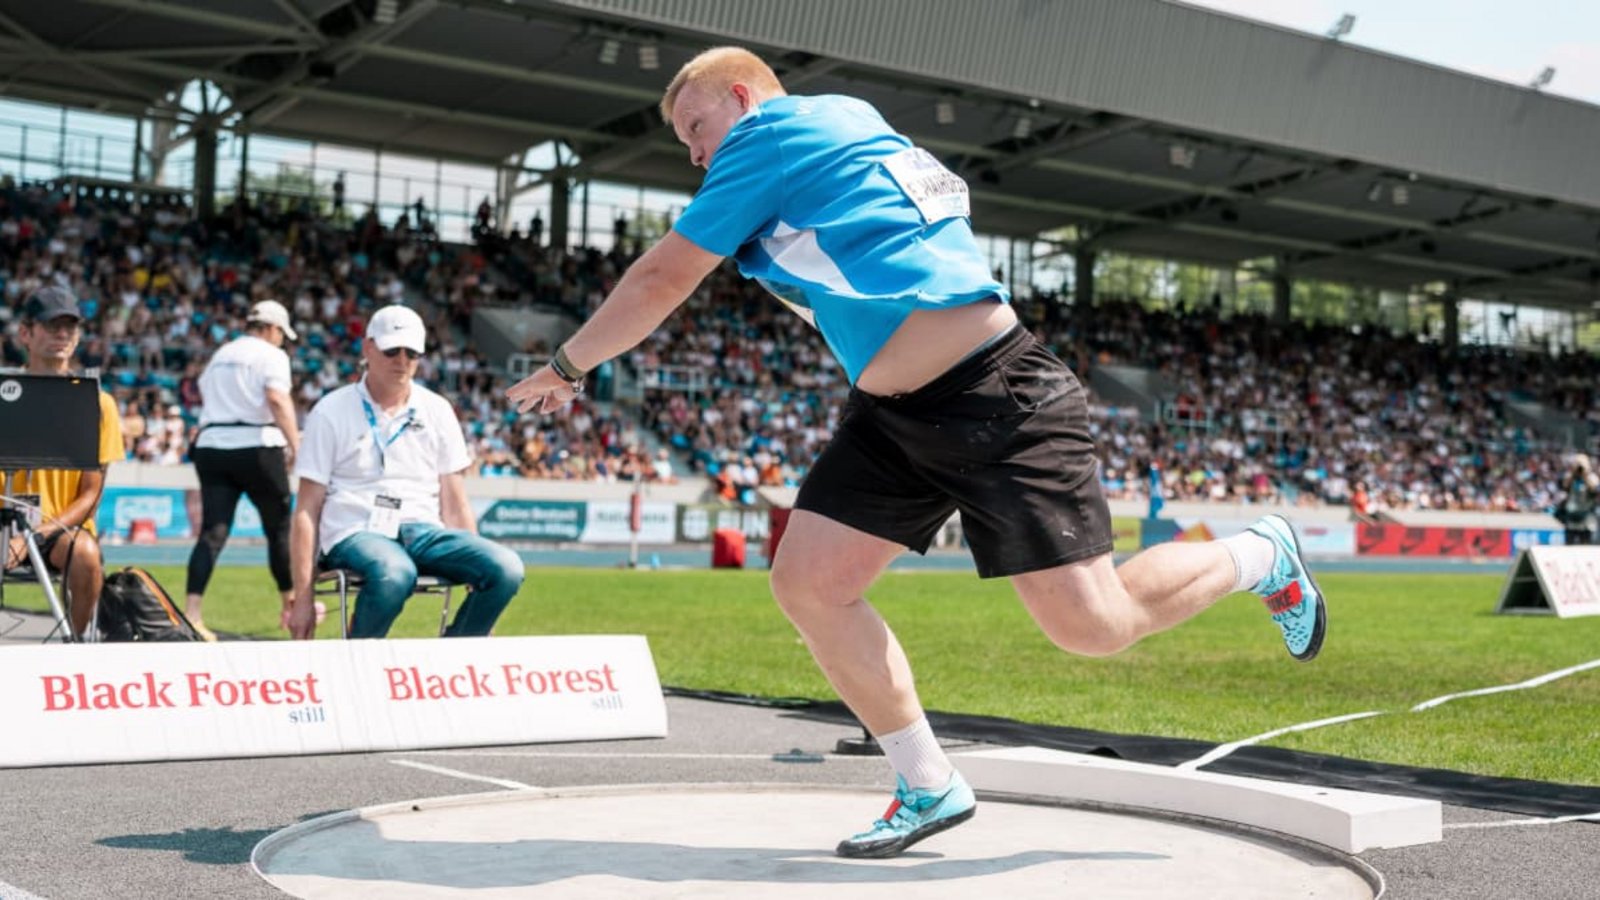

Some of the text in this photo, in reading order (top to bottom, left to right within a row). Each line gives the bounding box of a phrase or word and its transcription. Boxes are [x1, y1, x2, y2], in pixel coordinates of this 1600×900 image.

[39, 671, 323, 711] Black Forest
[384, 663, 619, 701] Black Forest
[288, 706, 326, 724] still
[591, 694, 623, 710] still
